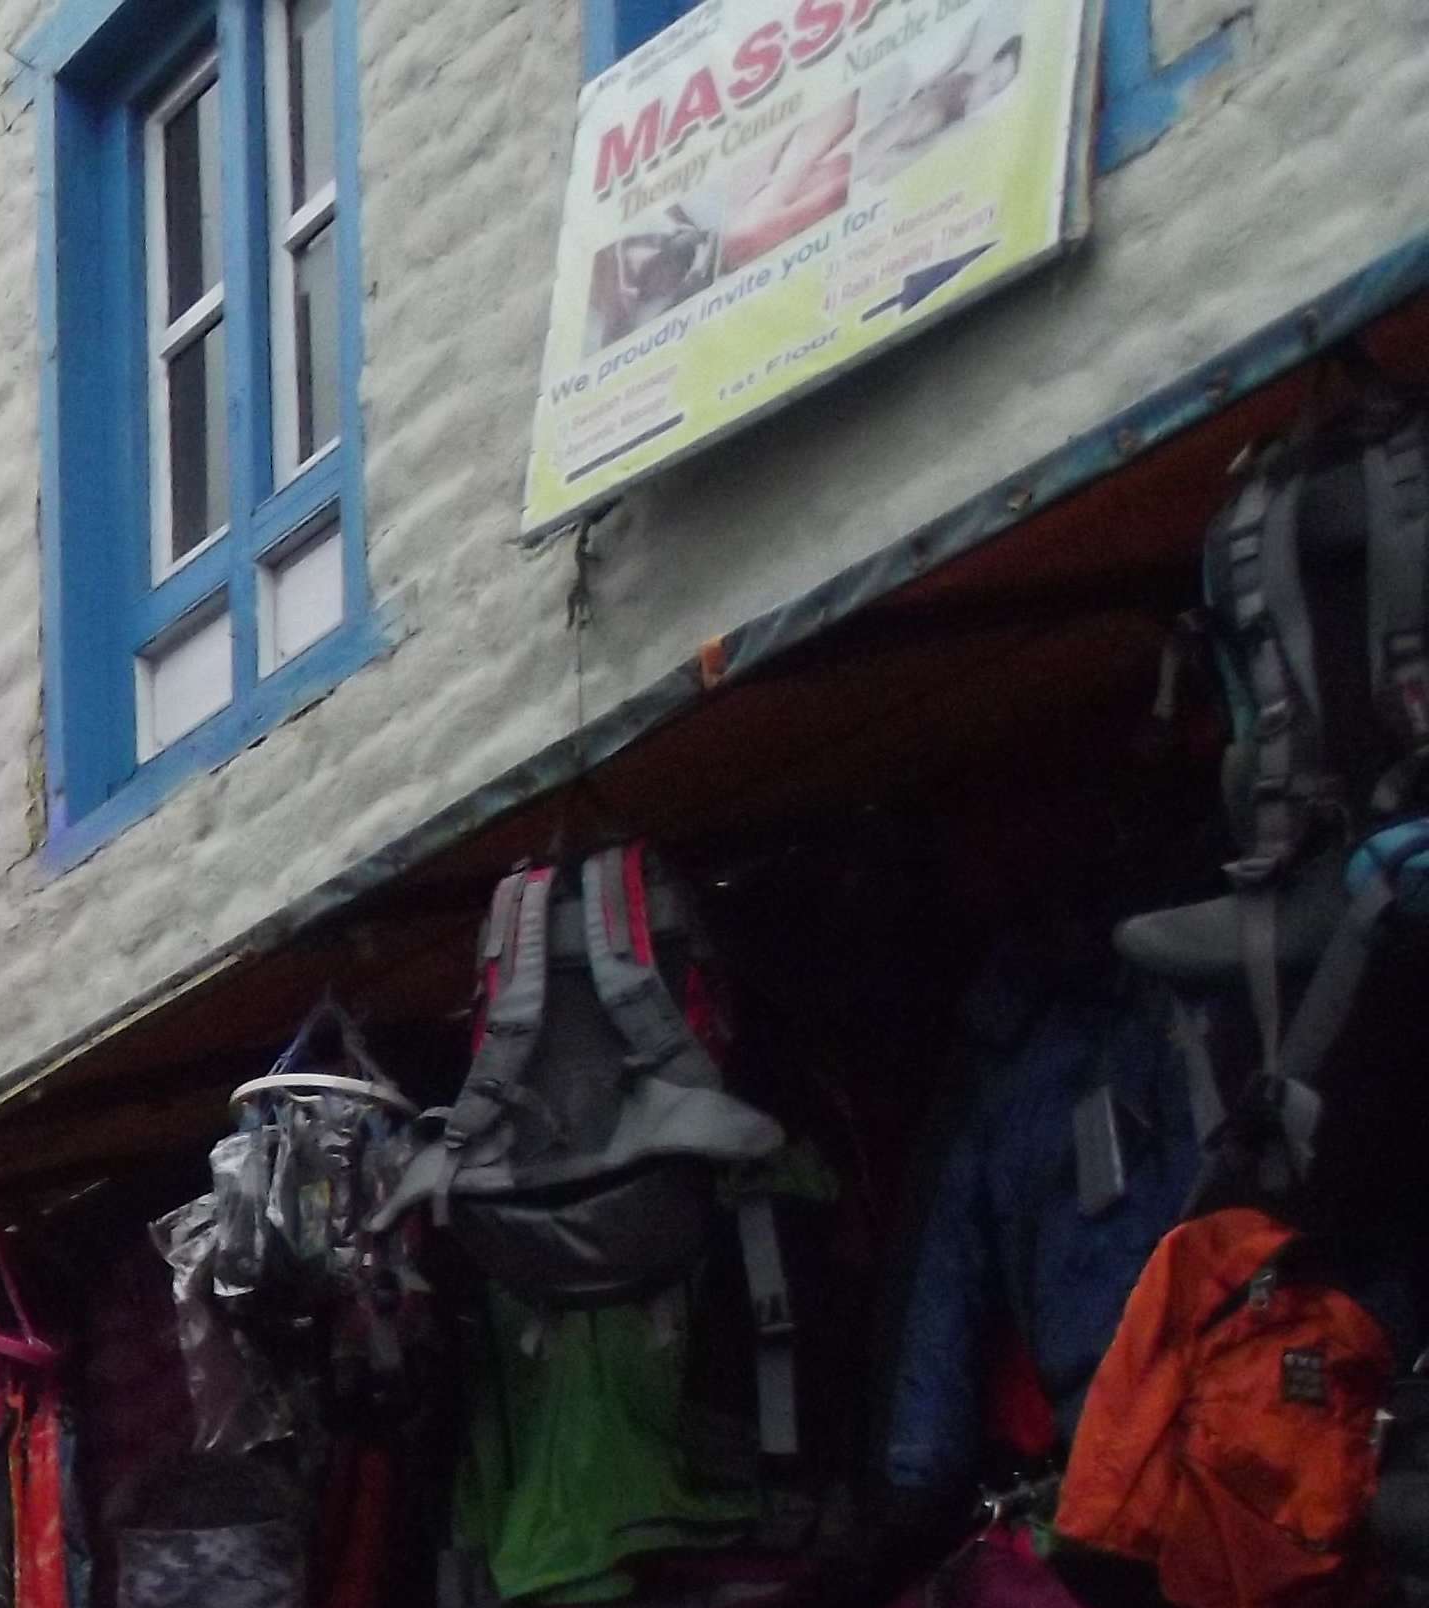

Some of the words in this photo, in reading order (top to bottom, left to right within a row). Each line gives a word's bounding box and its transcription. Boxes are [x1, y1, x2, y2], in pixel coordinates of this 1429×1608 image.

[593, 0, 876, 202] MASS
[549, 373, 590, 405] We
[597, 315, 689, 384] proudly
[700, 266, 772, 322] invite
[781, 231, 832, 280] you
[841, 198, 889, 238] for
